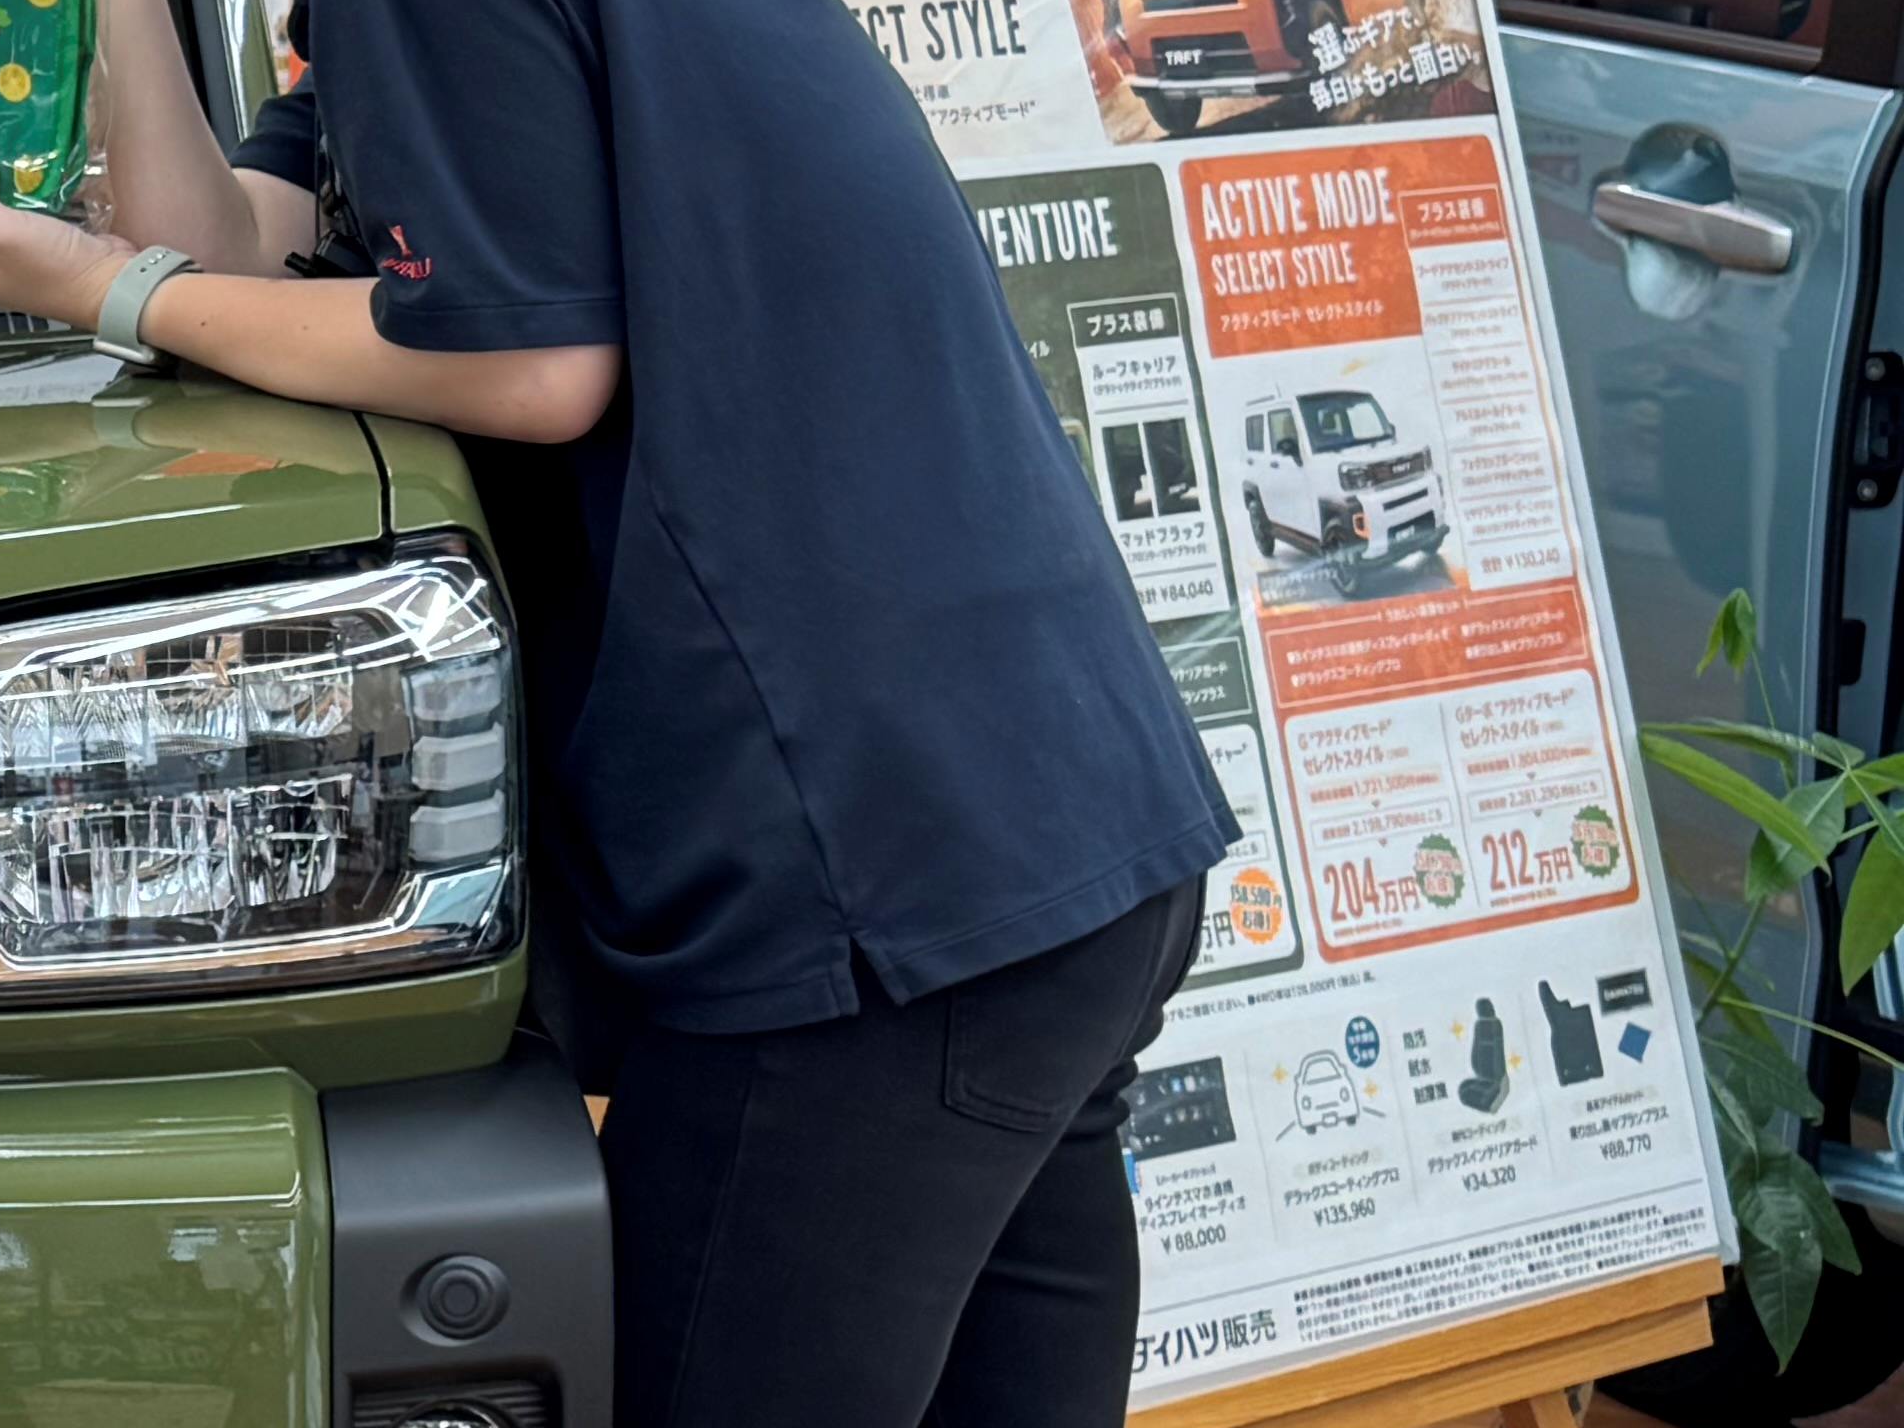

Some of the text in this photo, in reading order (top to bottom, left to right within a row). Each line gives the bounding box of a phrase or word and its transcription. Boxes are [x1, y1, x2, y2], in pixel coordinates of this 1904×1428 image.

[1308, 40, 1481, 112] 毎日はもっと面白い。
[1201, 167, 1398, 241] ACTIVE MODE
[1211, 240, 1358, 296] SELECT STYLE
[1600, 1133, 1652, 1160] ¥88,770
